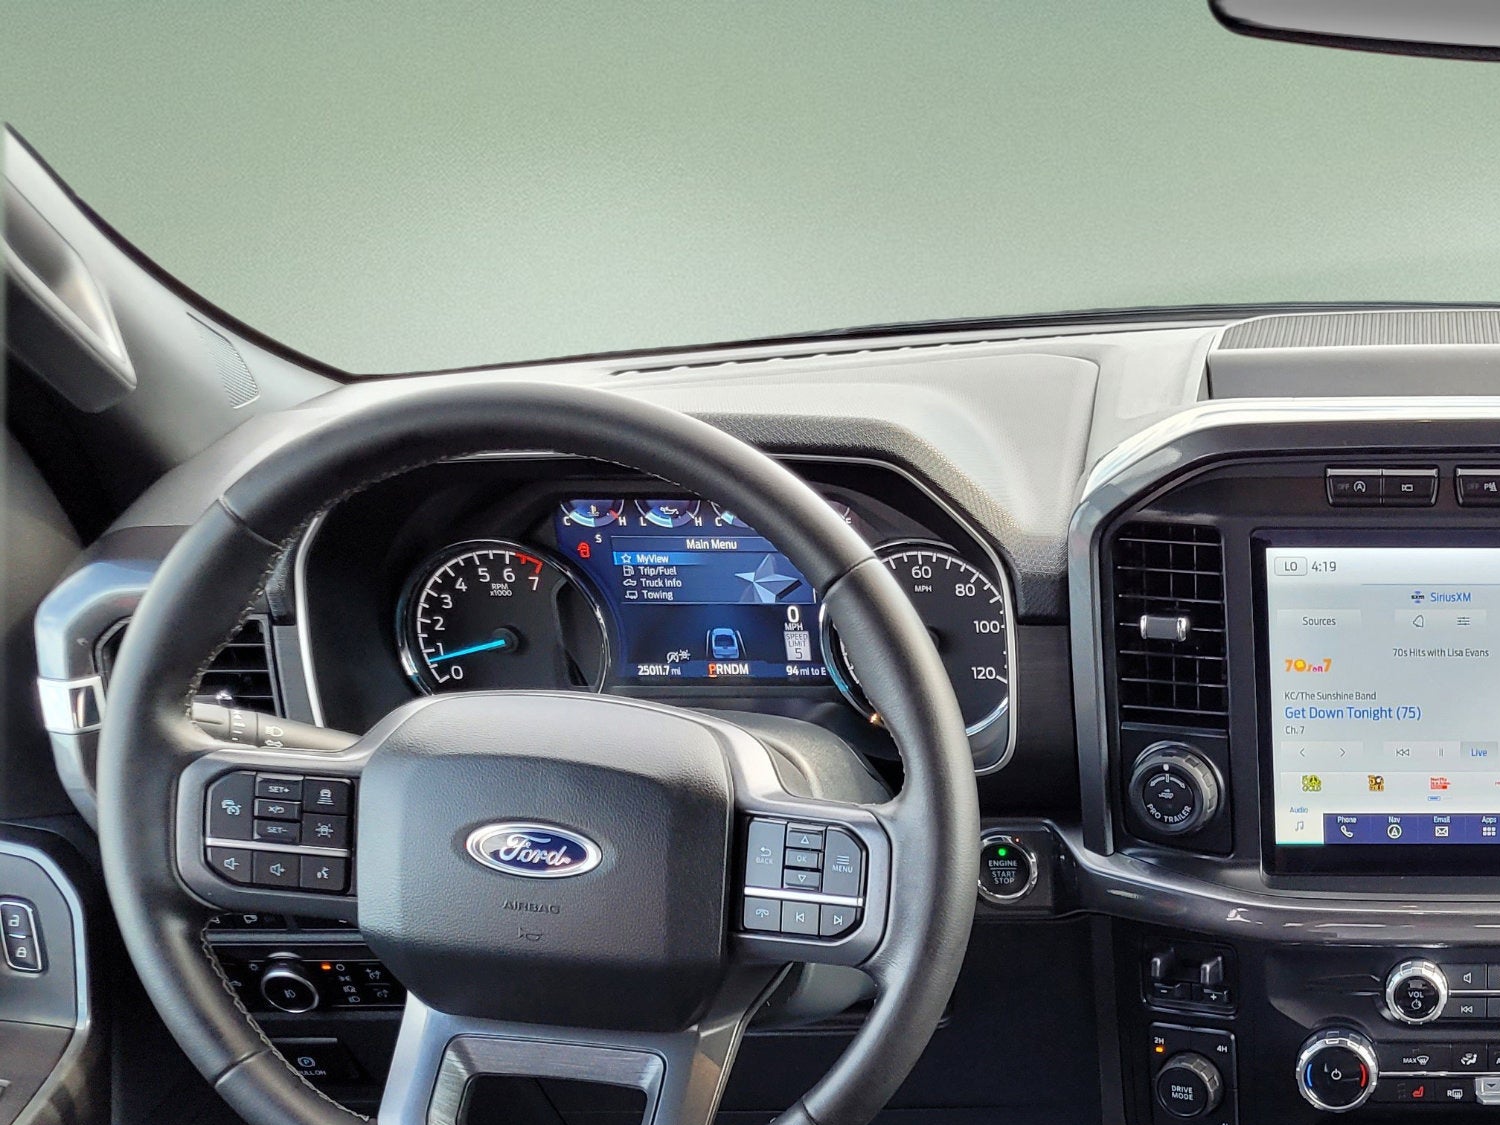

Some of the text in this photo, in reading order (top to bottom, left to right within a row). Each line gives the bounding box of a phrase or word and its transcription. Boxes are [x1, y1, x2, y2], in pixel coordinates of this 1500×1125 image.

[563, 516, 571, 526] C
[618, 516, 627, 526] H
[640, 516, 648, 526] L
[694, 516, 703, 527] H
[715, 516, 723, 527] C
[686, 539, 737, 550] Main Menu
[636, 553, 669, 565] MyView
[639, 565, 677, 577] Trip/Fuel
[1284, 561, 1298, 572] LO
[1311, 561, 1337, 572] 4:19
[478, 568, 490, 583] 5
[503, 568, 516, 583] 6
[911, 566, 932, 579] 60
[455, 577, 467, 592] 4
[528, 576, 539, 591] 7
[640, 578, 682, 588] Truck Info
[641, 589, 674, 600] Towing
[955, 583, 976, 597] 80
[440, 594, 453, 609] 3
[1430, 592, 1472, 603] SiriusXM
[786, 605, 800, 623] 0
[433, 616, 446, 631] 2
[1302, 616, 1337, 626] Sources
[784, 622, 803, 632] MPH
[973, 620, 1000, 634] 100
[786, 633, 808, 641] SPEED
[787, 640, 808, 648] LIMIT
[436, 643, 444, 657] 1
[795, 647, 803, 660] 5
[1392, 647, 1490, 657] 70s Hits with Lisa Evans
[450, 665, 463, 680] 0
[638, 665, 682, 676] 25011.7 mi
[708, 663, 749, 676] PRNDM
[786, 666, 827, 677] 94 mi to E
[971, 667, 996, 680] 120
[1284, 691, 1377, 701] KC/The Sunshine Band
[1285, 706, 1421, 721] Get Down Tonight (75)
[1285, 725, 1305, 735] Ch. 7
[1471, 748, 1488, 757] Live
[1146, 803, 1192, 823] PRO TRAILER
[1289, 806, 1309, 814] Audio
[1337, 816, 1357, 824] Phone
[1388, 816, 1401, 824] Nav
[1433, 816, 1451, 824] Email
[1481, 816, 1497, 824] Apps
[500, 834, 571, 866] Ford
[797, 855, 807, 863] OK
[832, 865, 853, 873] MENU
[991, 870, 1016, 878] START
[502, 900, 561, 914] AIRBAG
[1154, 1036, 1164, 1045] 2H
[1216, 1045, 1228, 1053] 4H
[1171, 1085, 1193, 1094] DRIVE
[1171, 1092, 1194, 1101] MODE
